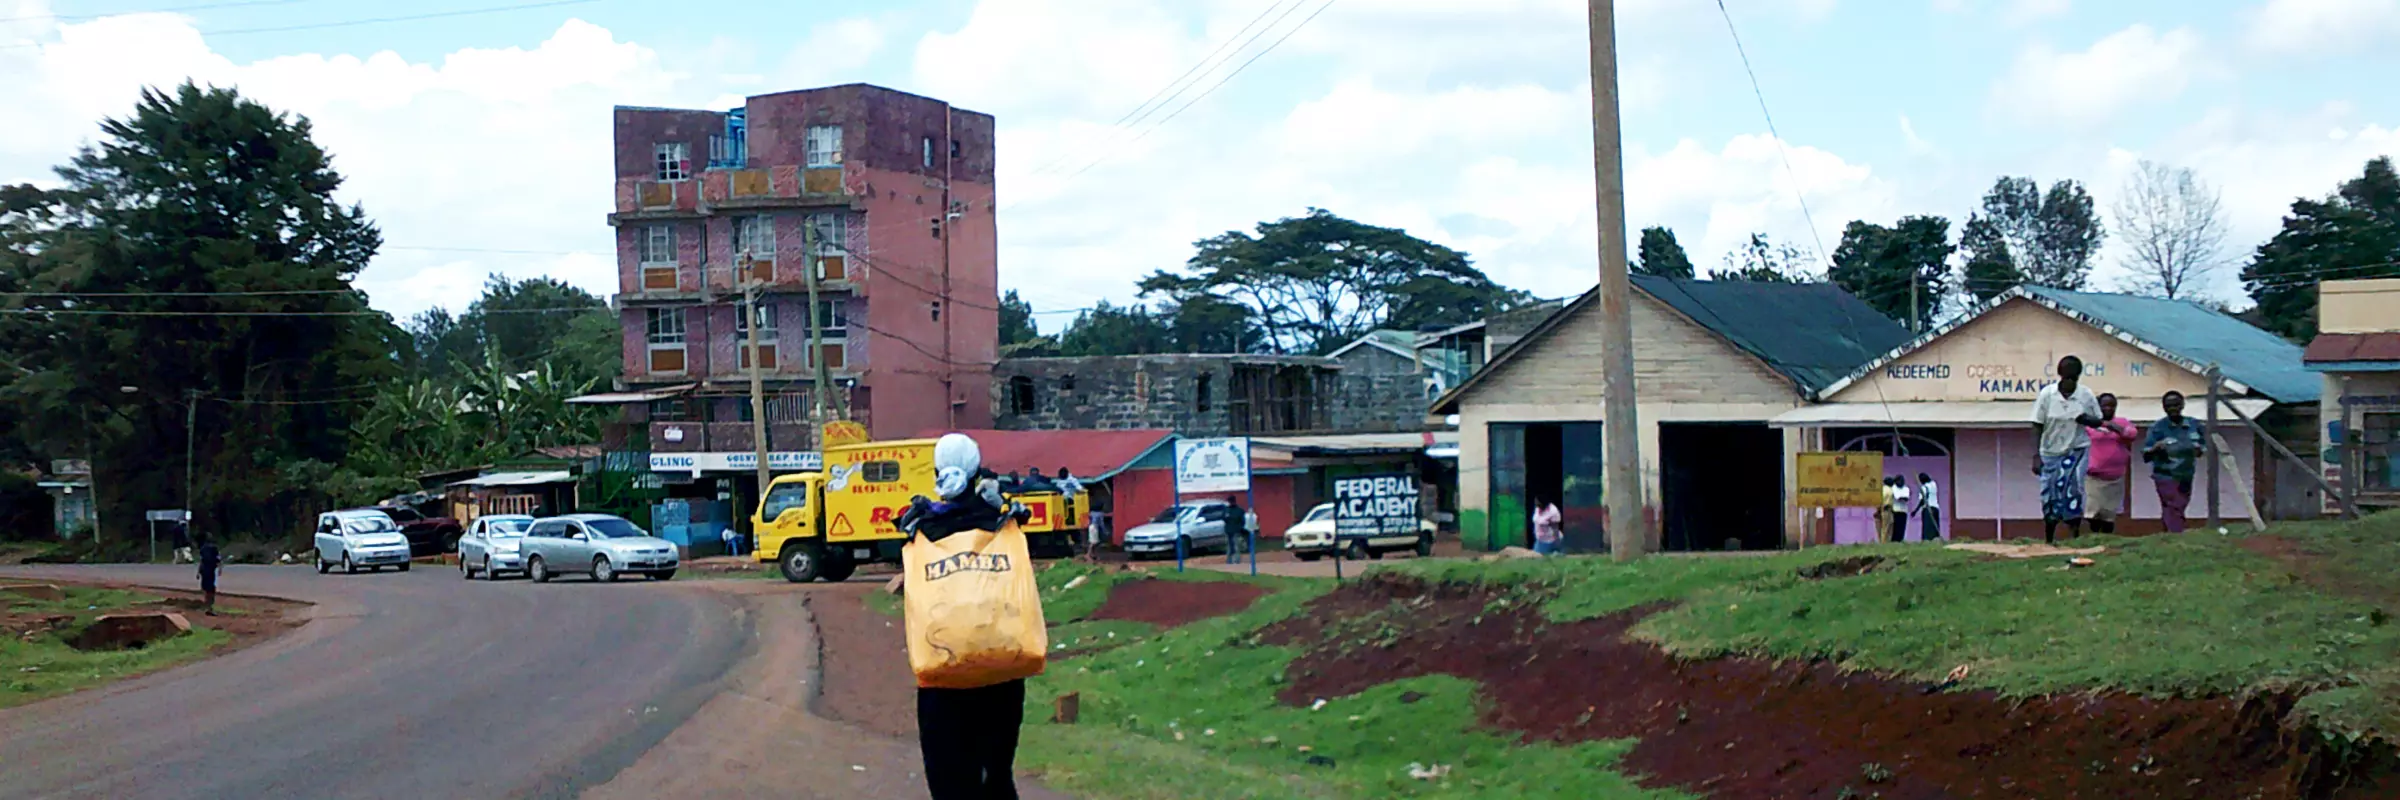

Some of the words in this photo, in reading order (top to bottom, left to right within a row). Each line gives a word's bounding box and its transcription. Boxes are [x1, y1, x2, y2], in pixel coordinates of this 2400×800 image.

[1887, 364, 1950, 379] REDEEMED
[1966, 364, 2017, 378] GOSPEL
[2043, 362, 2105, 377] CCH
[1979, 379, 2057, 393] KAMAKW
[650, 456, 694, 468] CLINIC
[794, 453, 822, 462] OFFIC
[1334, 475, 1419, 499] FEDERAL
[1337, 496, 1418, 518] ACADEMY
[925, 551, 1011, 581] MAMBA
